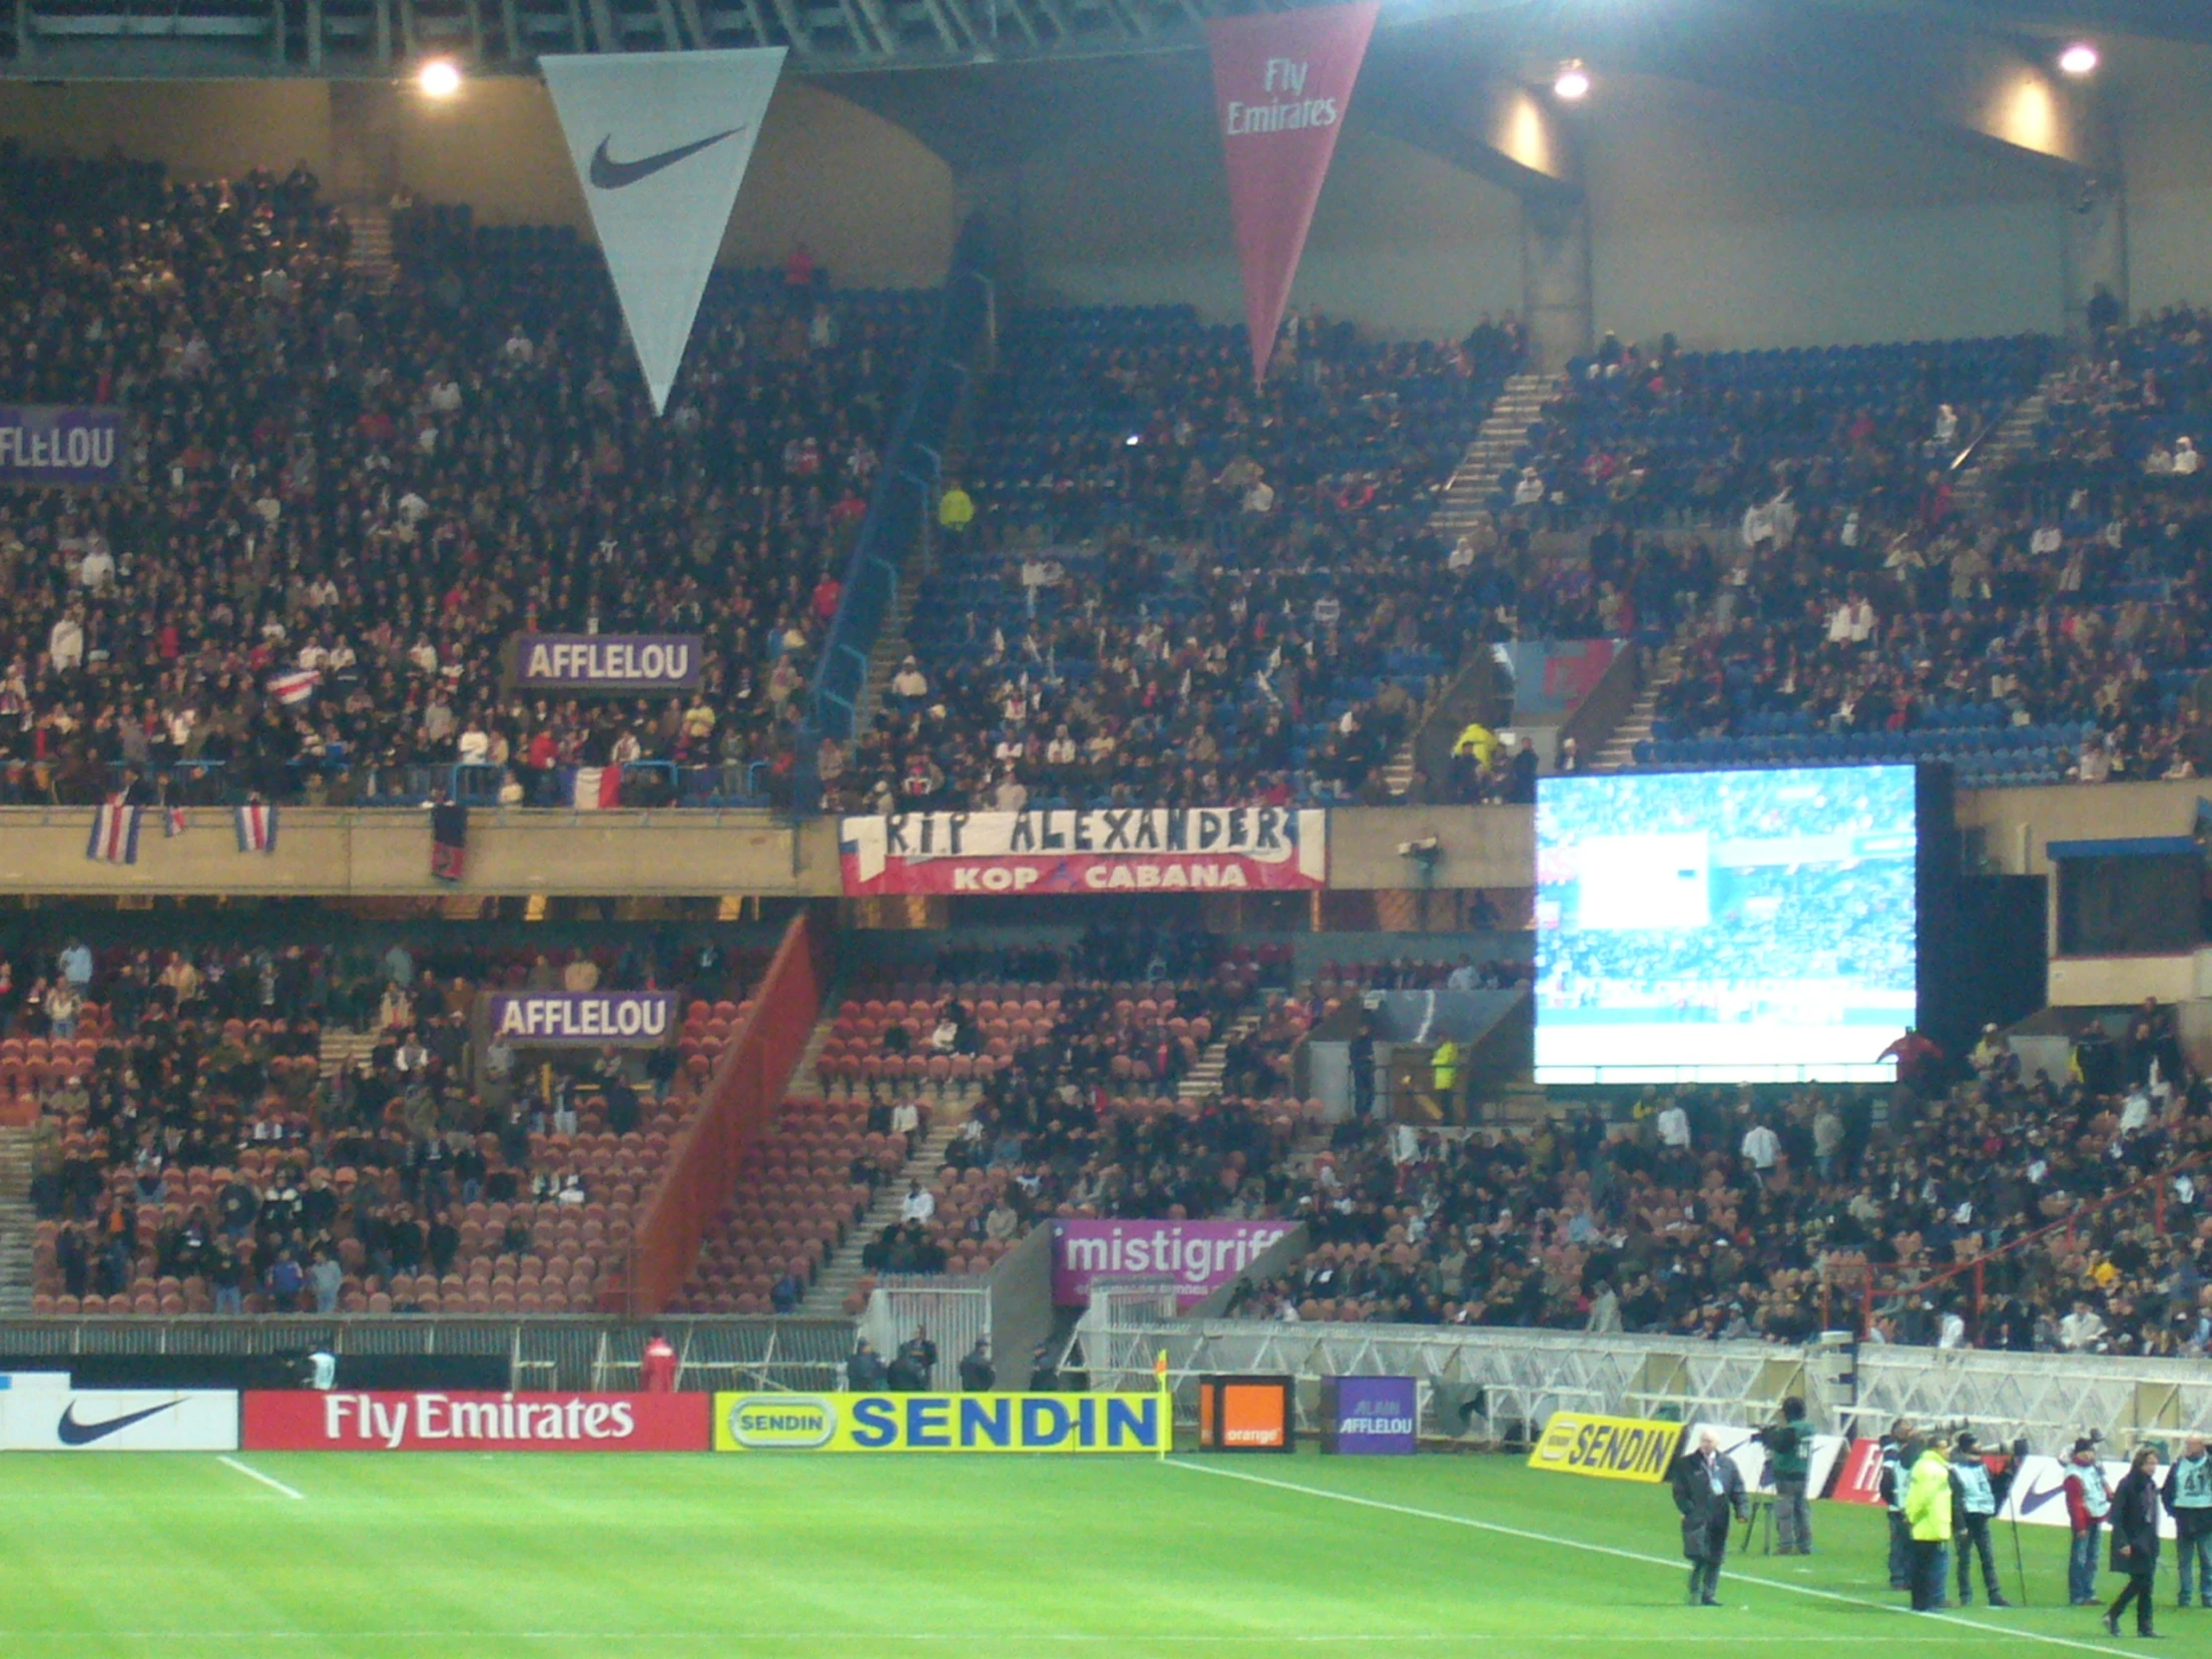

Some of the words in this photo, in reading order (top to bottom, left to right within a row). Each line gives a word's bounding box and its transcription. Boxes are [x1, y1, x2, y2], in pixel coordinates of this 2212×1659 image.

[1264, 57, 1309, 96] Fly
[1227, 97, 1338, 135] Emirates
[526, 643, 689, 679] AFFLELOU
[1009, 807, 1282, 851] ALEXANDER
[953, 865, 1039, 891] KOP
[1085, 862, 1247, 888] CABANA
[501, 999, 666, 1035] AFFLELOU
[324, 1393, 407, 1448] Fly
[415, 1391, 634, 1439] Emirates
[741, 1415, 823, 1430] SENDIN
[850, 1397, 1158, 1447] SENDIN
[1341, 1417, 1411, 1433] AFFLELOU
[1568, 1423, 1674, 1473] SENDIN
